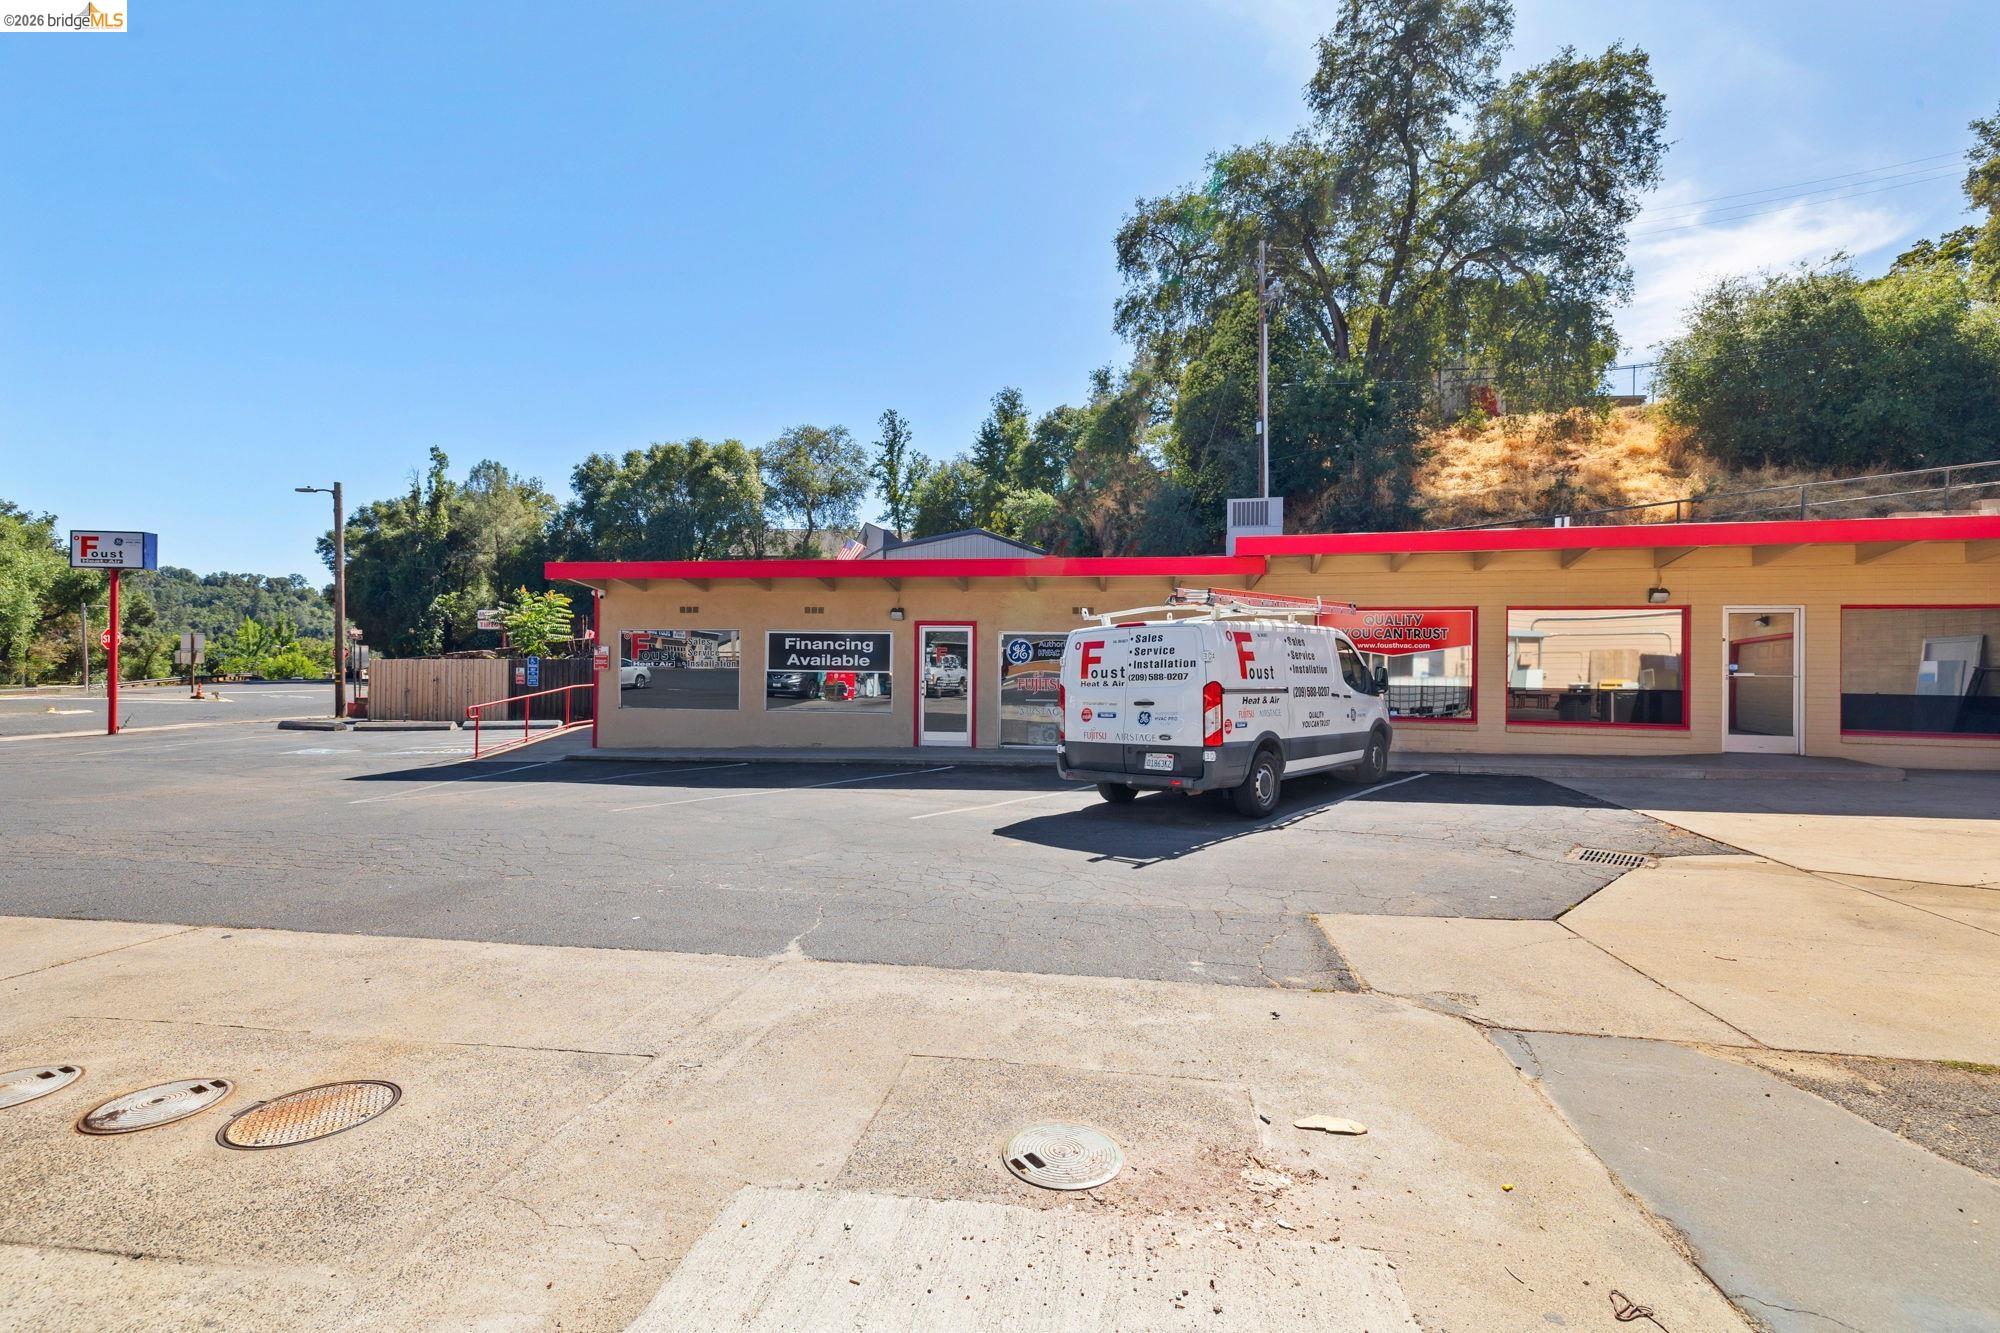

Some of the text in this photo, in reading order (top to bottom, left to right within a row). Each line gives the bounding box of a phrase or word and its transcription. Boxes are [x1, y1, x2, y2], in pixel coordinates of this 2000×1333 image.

[1363, 614, 1424, 626] QUALITY
[1135, 633, 1164, 644] Sales
[1342, 628, 1449, 640] YOU CAN TRUST
[688, 638, 712, 646] Sales
[784, 637, 874, 653] Financing
[1287, 636, 1306, 646] Sales
[688, 648, 720, 657] Service
[1134, 646, 1175, 656] Service
[1290, 650, 1316, 660] Service
[687, 660, 736, 668] Installation
[786, 653, 870, 667] Available
[1133, 659, 1197, 669] Installation
[1292, 664, 1328, 674] Installation
[1128, 672, 1188, 682] (209) 588-0207
[1080, 680, 1101, 688] Heat
[1112, 680, 1125, 688] Air
[1292, 686, 1330, 698] (209) 588-0207
[1242, 696, 1280, 705] Heat & Air
[1308, 711, 1324, 719] QUALITY
[1302, 720, 1313, 728] YOU
[1320, 719, 1331, 728] TRUST
[1083, 730, 1107, 740] FUJITSU
[1115, 732, 1158, 742] AIRSTAGE
